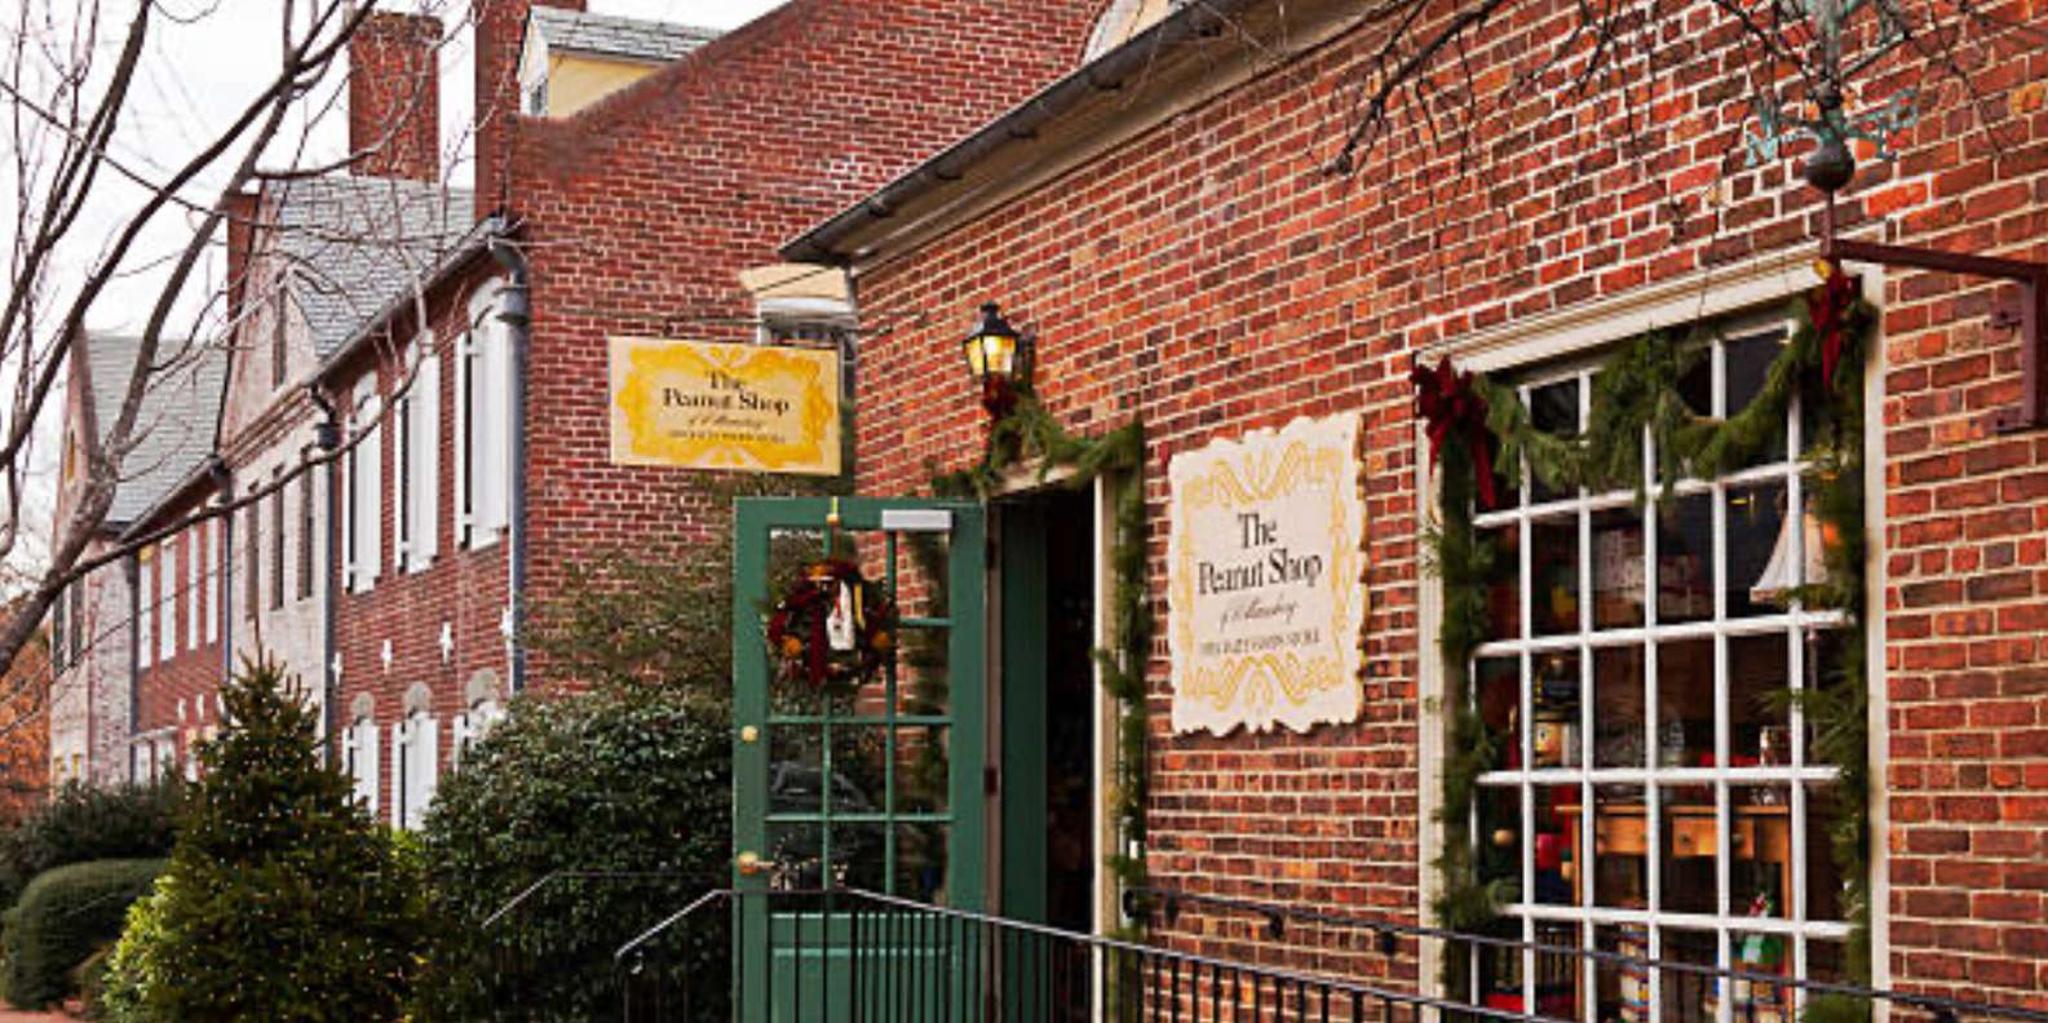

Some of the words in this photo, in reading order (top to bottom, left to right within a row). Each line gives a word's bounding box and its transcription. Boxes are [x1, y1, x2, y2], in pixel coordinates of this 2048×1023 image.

[704, 369, 743, 389] The
[662, 387, 731, 409] Peanut
[738, 391, 789, 416] Shop
[1237, 511, 1277, 548] The
[1198, 560, 1263, 595] Peanut
[1268, 547, 1323, 588] Shop
